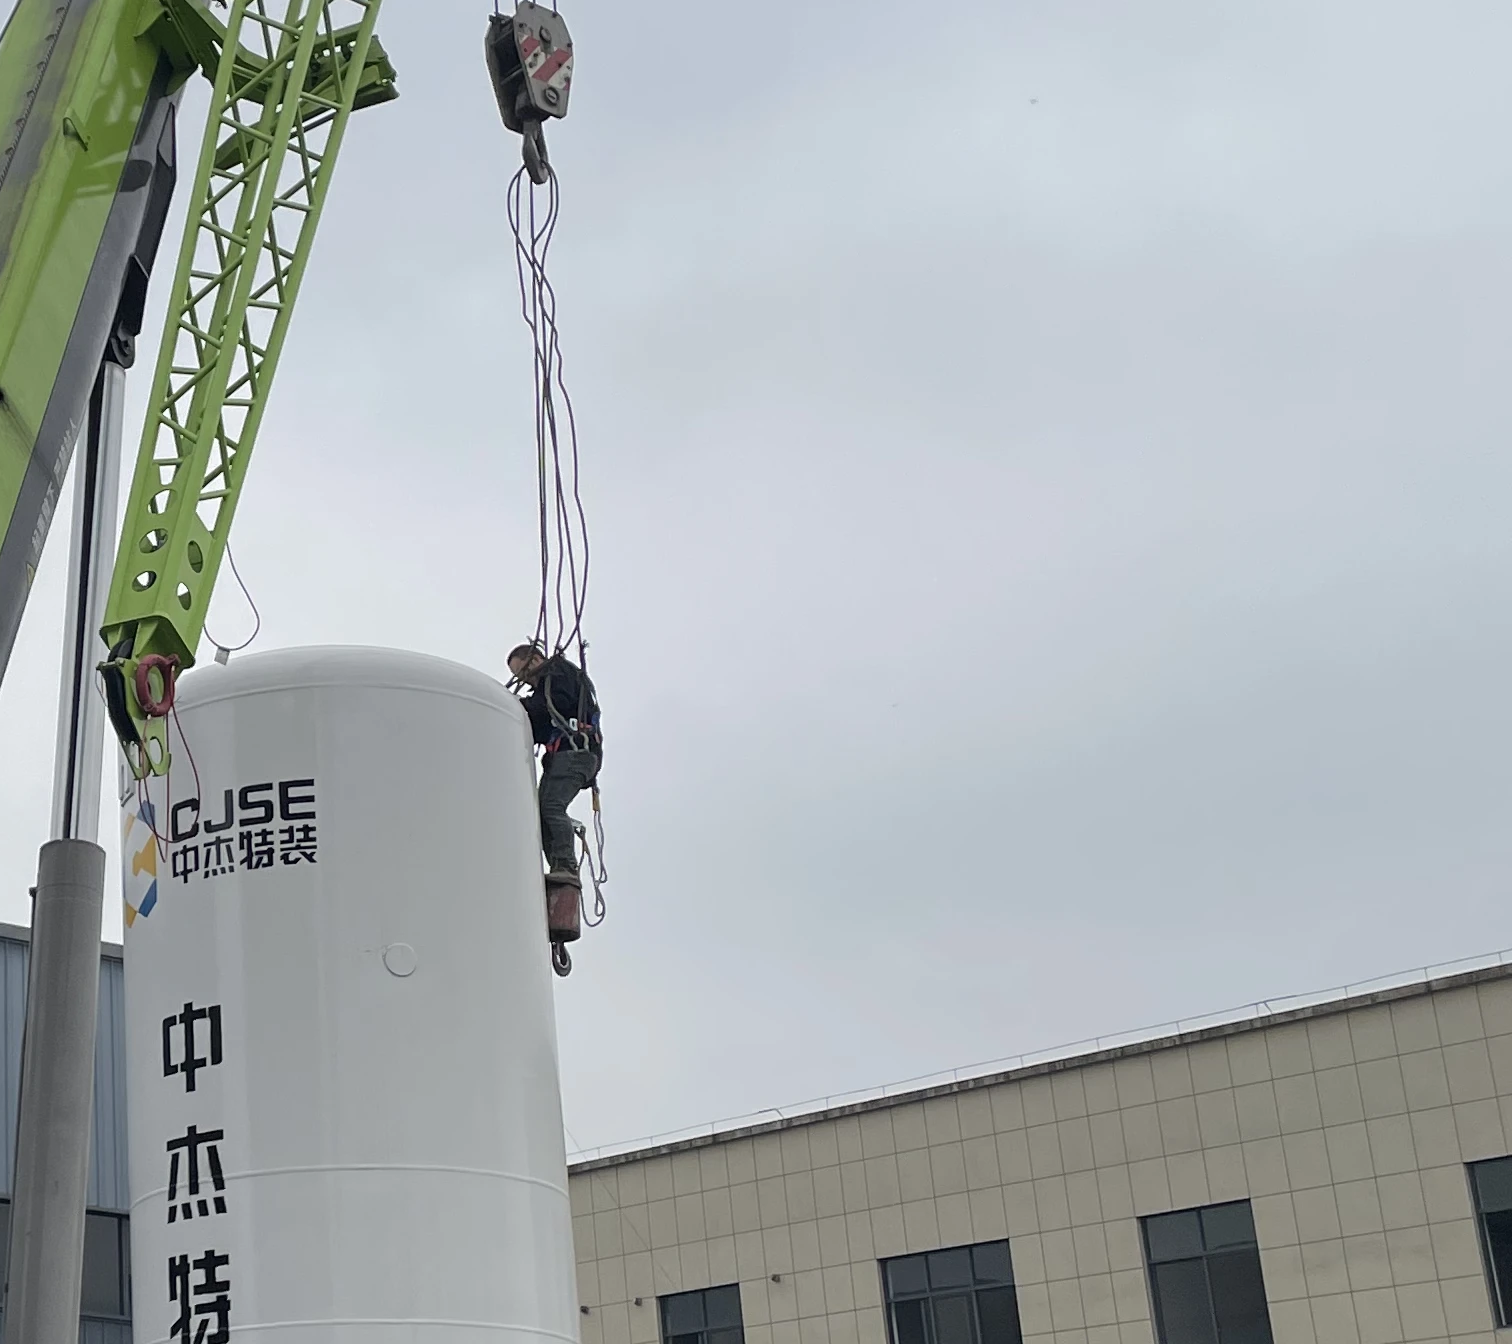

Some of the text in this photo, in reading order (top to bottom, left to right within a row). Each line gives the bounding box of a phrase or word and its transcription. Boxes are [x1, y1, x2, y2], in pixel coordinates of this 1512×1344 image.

[172, 779, 316, 843] CJSE
[172, 824, 318, 884] 中杰特装
